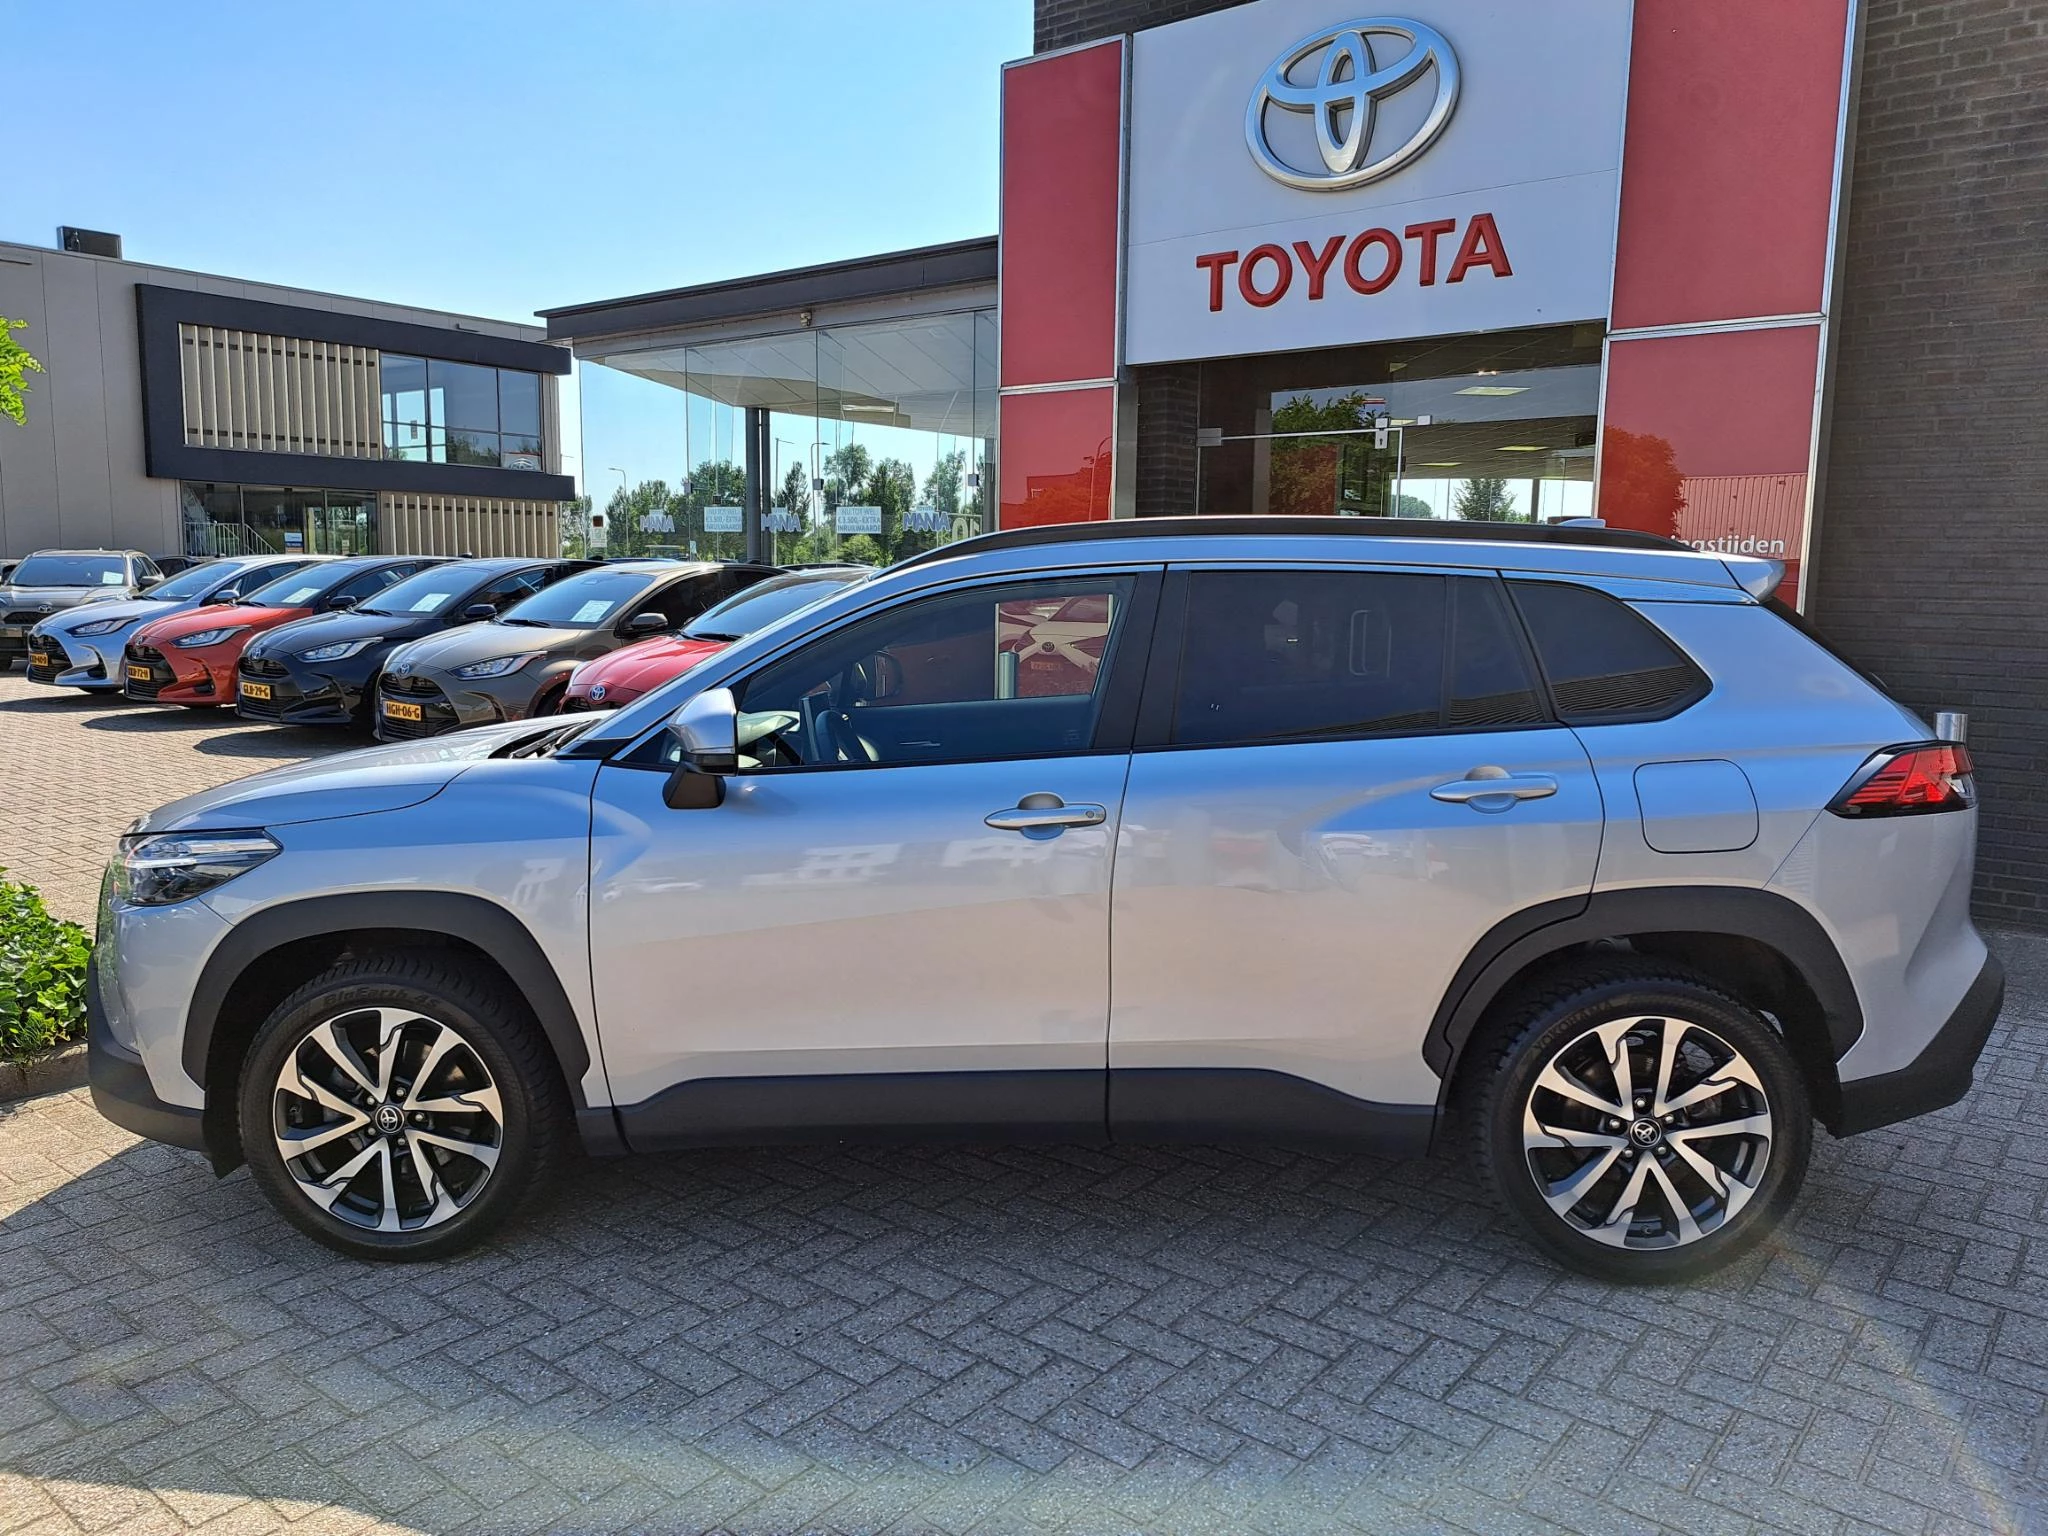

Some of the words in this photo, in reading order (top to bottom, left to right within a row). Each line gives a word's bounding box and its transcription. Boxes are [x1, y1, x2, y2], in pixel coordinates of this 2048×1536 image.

[1195, 212, 1513, 313] TOYOTA
[639, 515, 675, 532] MANIA
[761, 513, 802, 532] MANIA
[902, 511, 951, 532] MANIA
[386, 702, 420, 719] HGH-06-G
